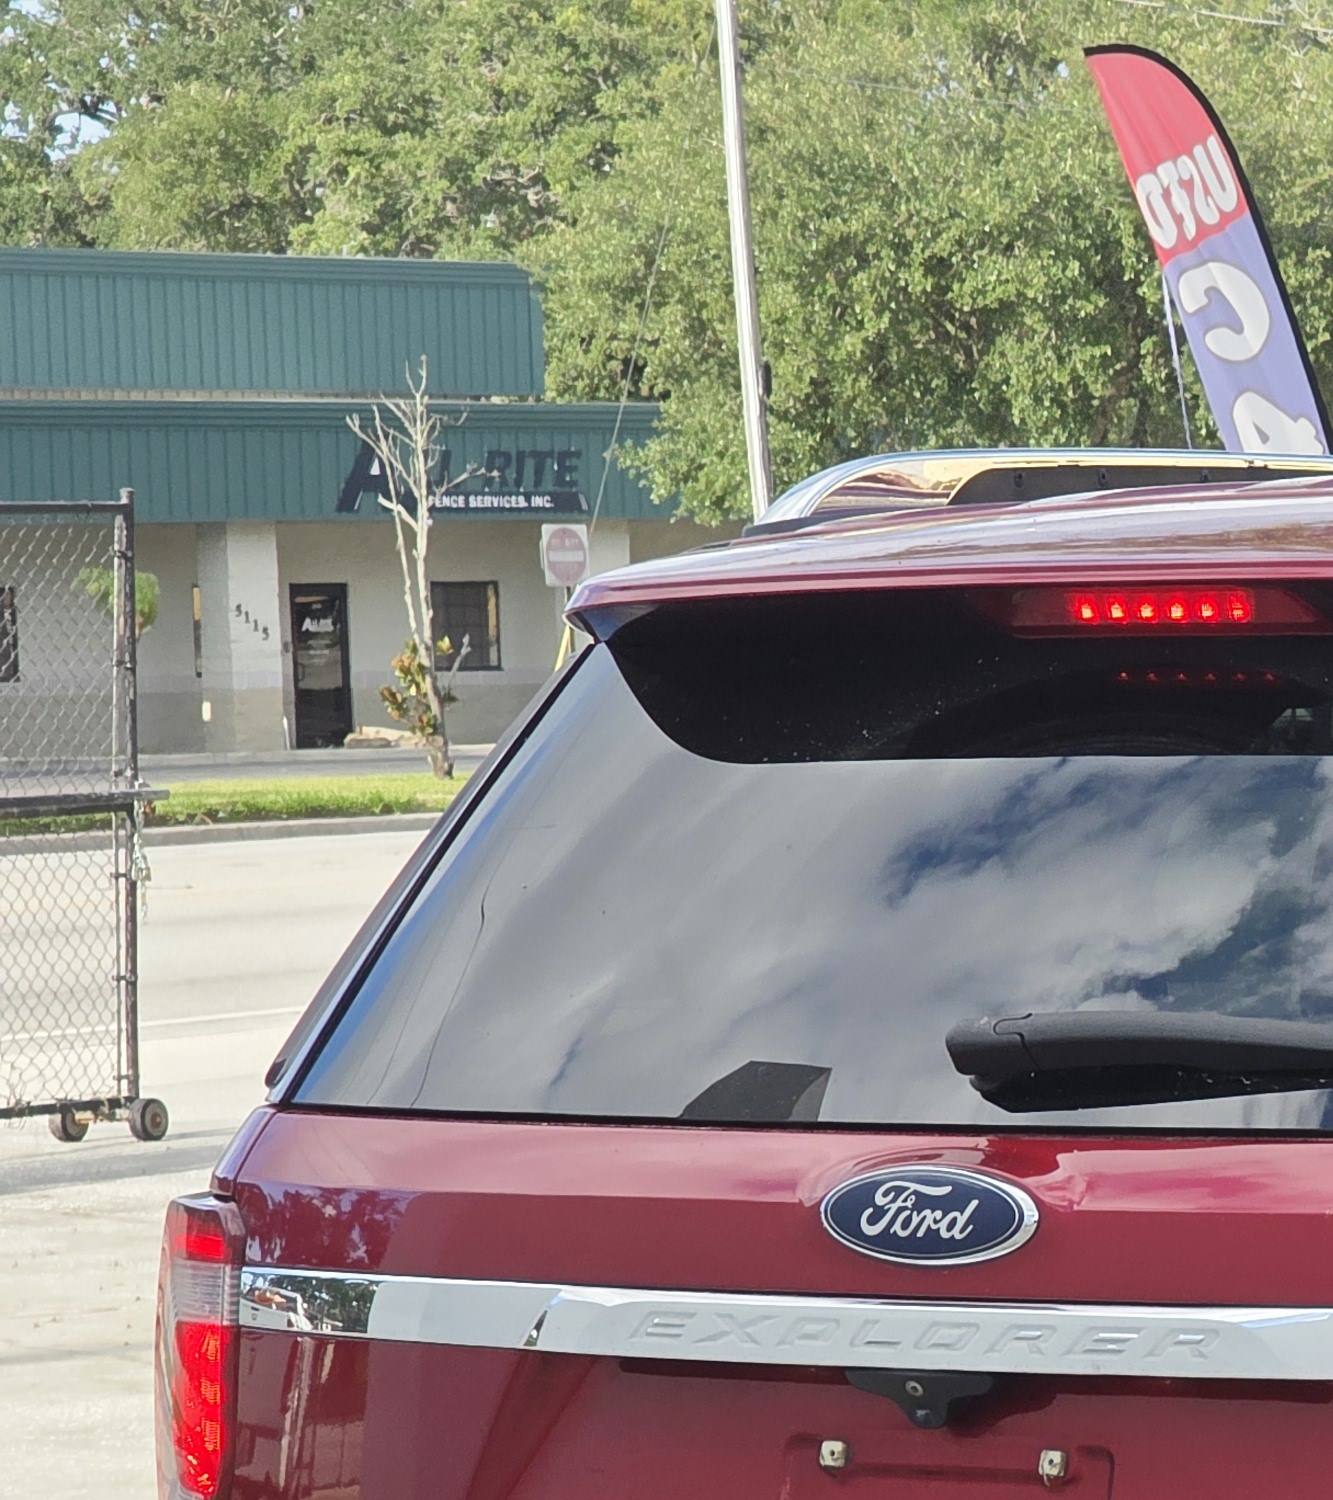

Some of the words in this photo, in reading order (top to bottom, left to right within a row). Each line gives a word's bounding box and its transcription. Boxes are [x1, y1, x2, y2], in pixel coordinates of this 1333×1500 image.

[428, 494, 466, 508] FENCE
[235, 603, 270, 641] 5115
[860, 1180, 979, 1240] Ford
[628, 1309, 1223, 1362] EXPLORER
